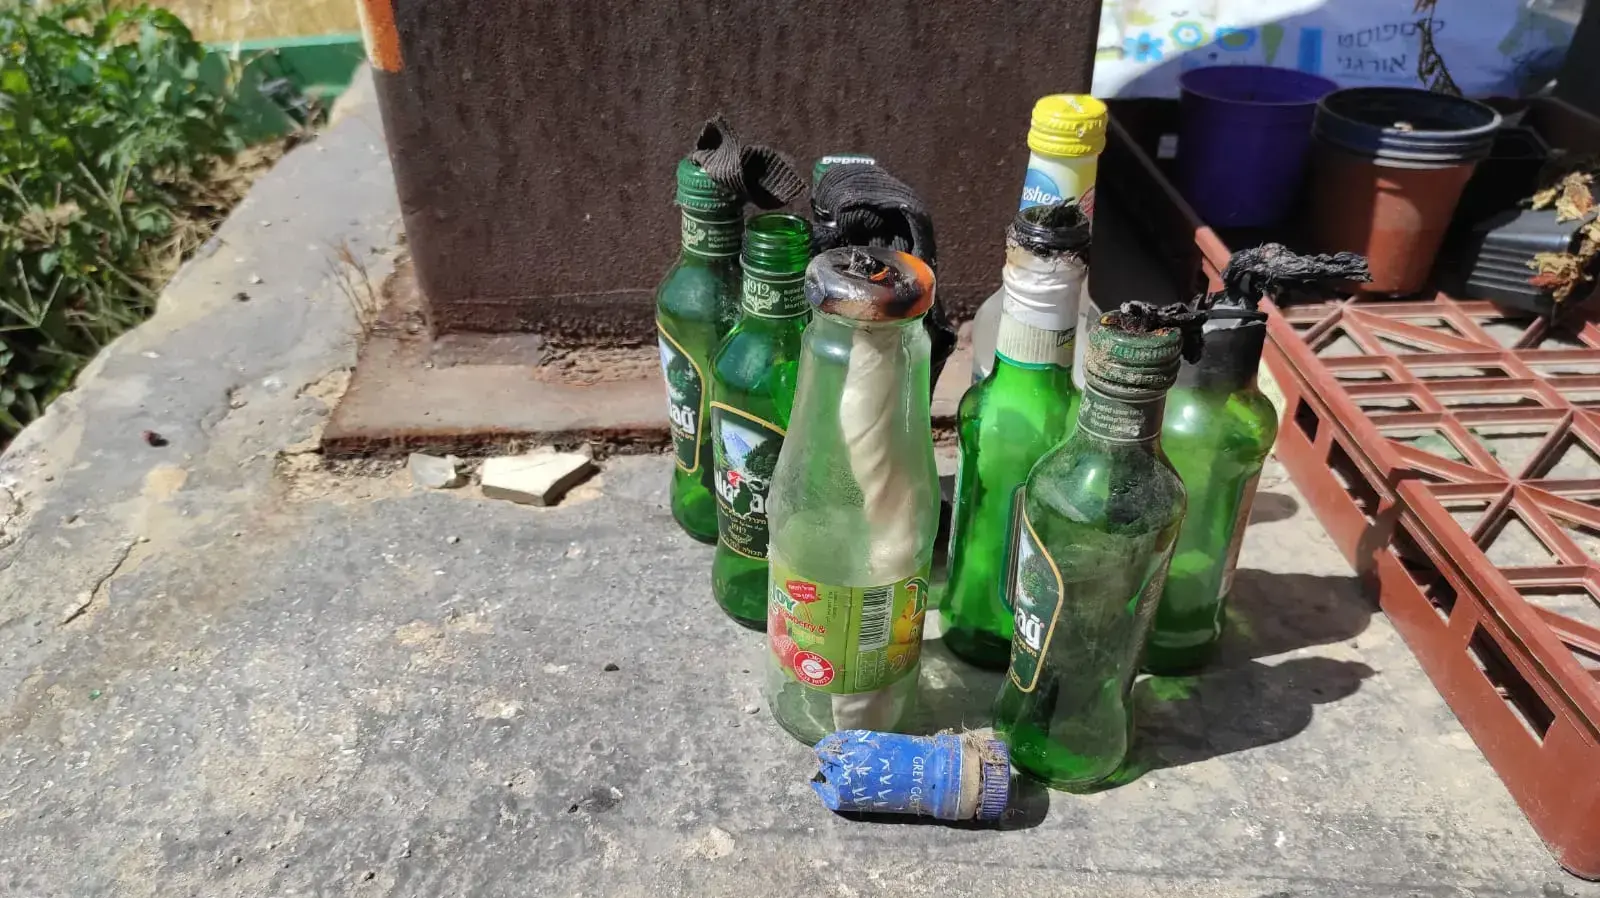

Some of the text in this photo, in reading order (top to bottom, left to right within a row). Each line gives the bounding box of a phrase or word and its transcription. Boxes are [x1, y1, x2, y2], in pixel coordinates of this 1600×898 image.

[1338, 20, 1446, 48] קמפוסט
[1338, 53, 1407, 73] אורגני
[746, 278, 771, 297] 1912
[912, 756, 924, 784] GREY
